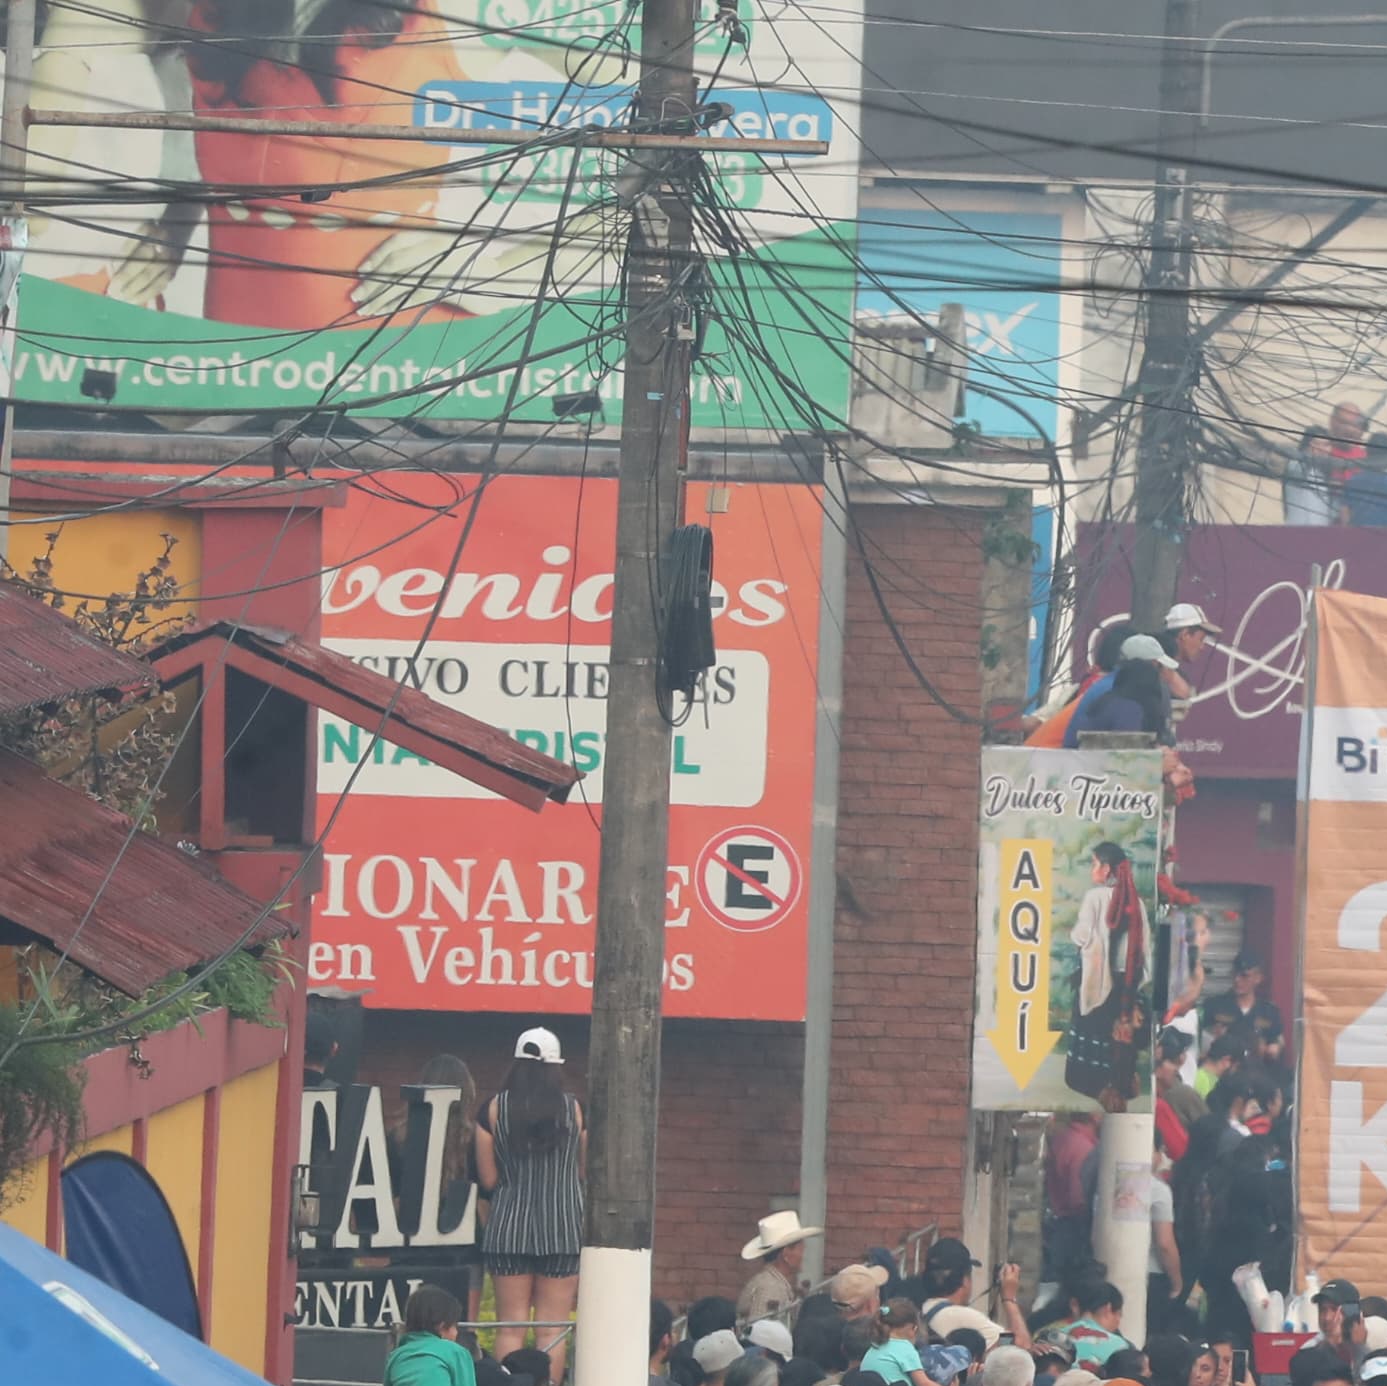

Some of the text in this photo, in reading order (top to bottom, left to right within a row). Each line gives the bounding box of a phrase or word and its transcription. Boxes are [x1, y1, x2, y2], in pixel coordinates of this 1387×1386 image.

[12, 351, 742, 406] ww.centrodentalcristalm
[499, 658, 737, 704] CLIEES
[1336, 736, 1378, 774] Bi
[984, 774, 1157, 822] Dulces Típicos
[320, 853, 691, 928] IONARE
[397, 925, 695, 991] Vehícus
[1010, 850, 1040, 1051] AQUÍ
